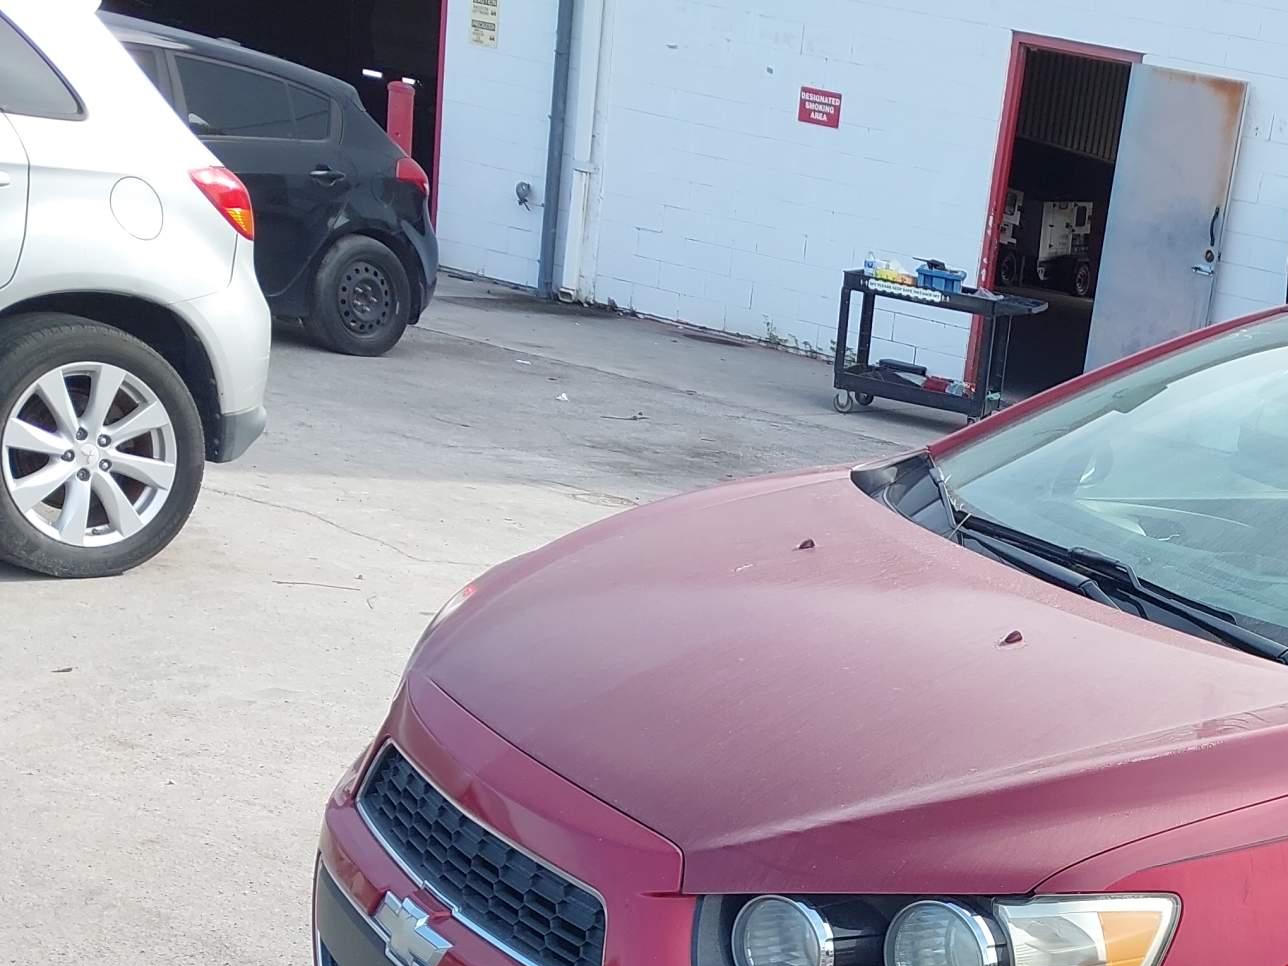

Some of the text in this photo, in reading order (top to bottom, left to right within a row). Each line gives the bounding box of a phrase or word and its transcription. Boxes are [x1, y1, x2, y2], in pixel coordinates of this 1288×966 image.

[801, 91, 840, 105] DESIGNATED
[805, 101, 834, 113] SMOKING
[810, 111, 827, 121] AREA
